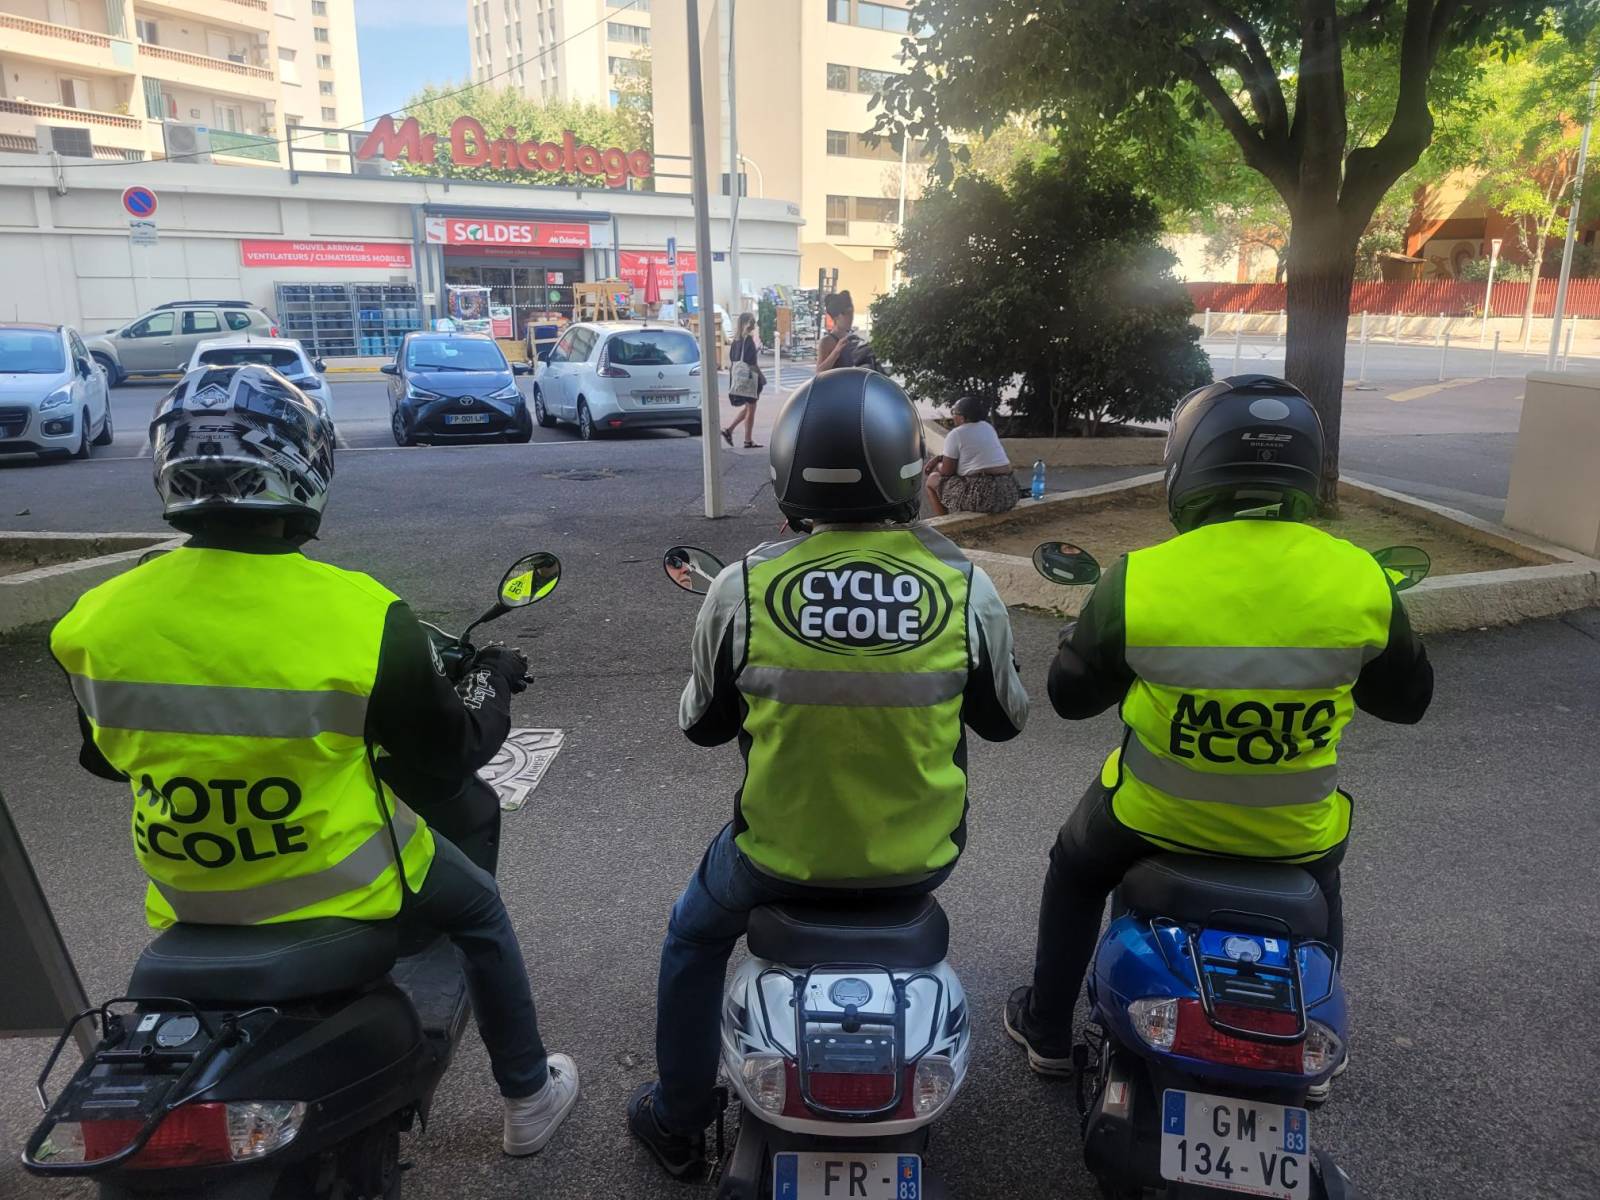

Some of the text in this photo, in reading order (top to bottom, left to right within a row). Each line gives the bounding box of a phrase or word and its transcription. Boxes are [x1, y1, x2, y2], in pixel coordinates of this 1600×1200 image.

[450, 116, 652, 188] Bricolage
[453, 222, 533, 243] SOLDES
[293, 243, 365, 252] NOUVEL ARRIVAGE
[247, 252, 309, 261] VENTILATEURS
[315, 254, 371, 262] CLIMATISEURS
[372, 255, 406, 263] MOBILES
[1241, 432, 1293, 442] LS2
[802, 570, 921, 603] CYCLO
[801, 605, 920, 641] ECOLE
[1170, 1116, 1178, 1128] F
[1286, 1132, 1304, 1151] 83
[782, 1182, 791, 1194] F
[899, 1181, 917, 1200] 83
